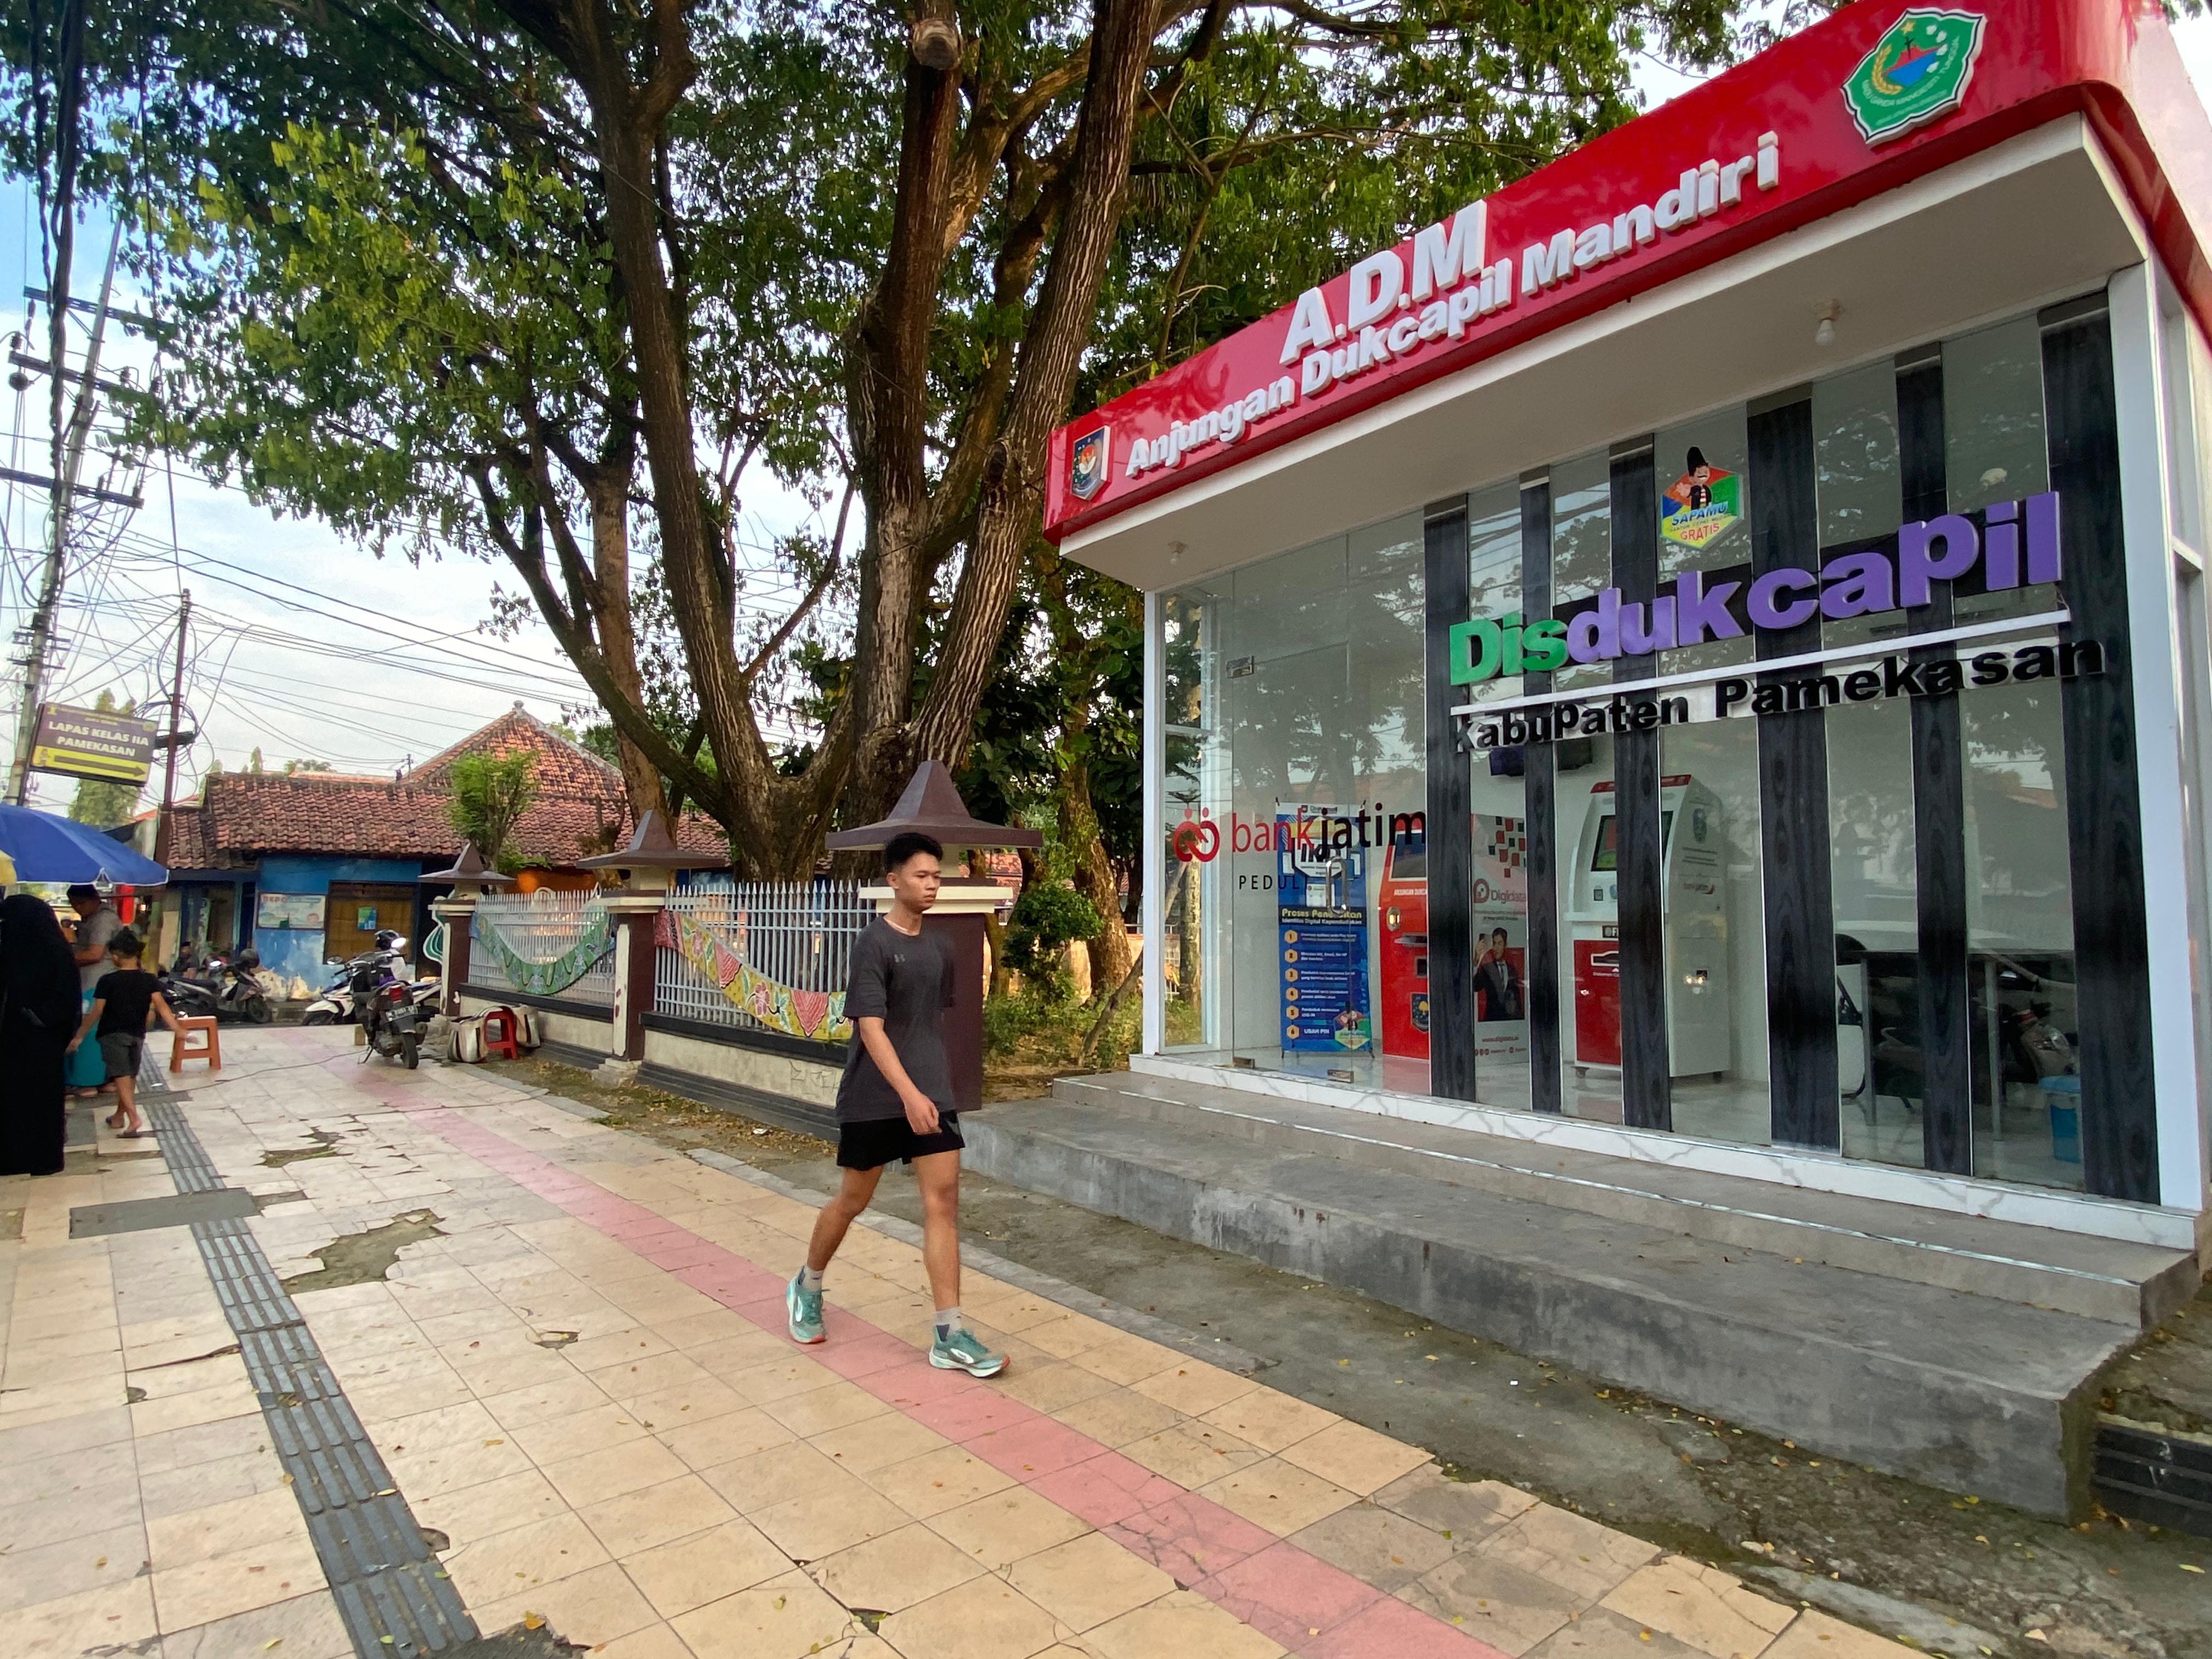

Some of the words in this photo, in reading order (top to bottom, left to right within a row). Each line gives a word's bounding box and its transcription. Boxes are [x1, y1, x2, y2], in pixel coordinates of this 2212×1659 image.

[1279, 199, 1487, 366] A.D.M
[1125, 375, 1295, 478] Anjungan
[1301, 257, 1513, 396] Dukcapil
[1521, 130, 1779, 296] Mandiri
[1672, 501, 1728, 526] SAPAMU
[1680, 522, 1720, 540] GRATIS
[1449, 490, 2062, 686] Disdukcapil
[1716, 639, 2106, 719] Pamekasan
[49, 721, 89, 736] LAPAS
[92, 729, 130, 742] KELAS
[132, 735, 149, 746] IIA
[57, 736, 136, 757] PAMEKASAN
[1282, 908, 1309, 917] Proses
